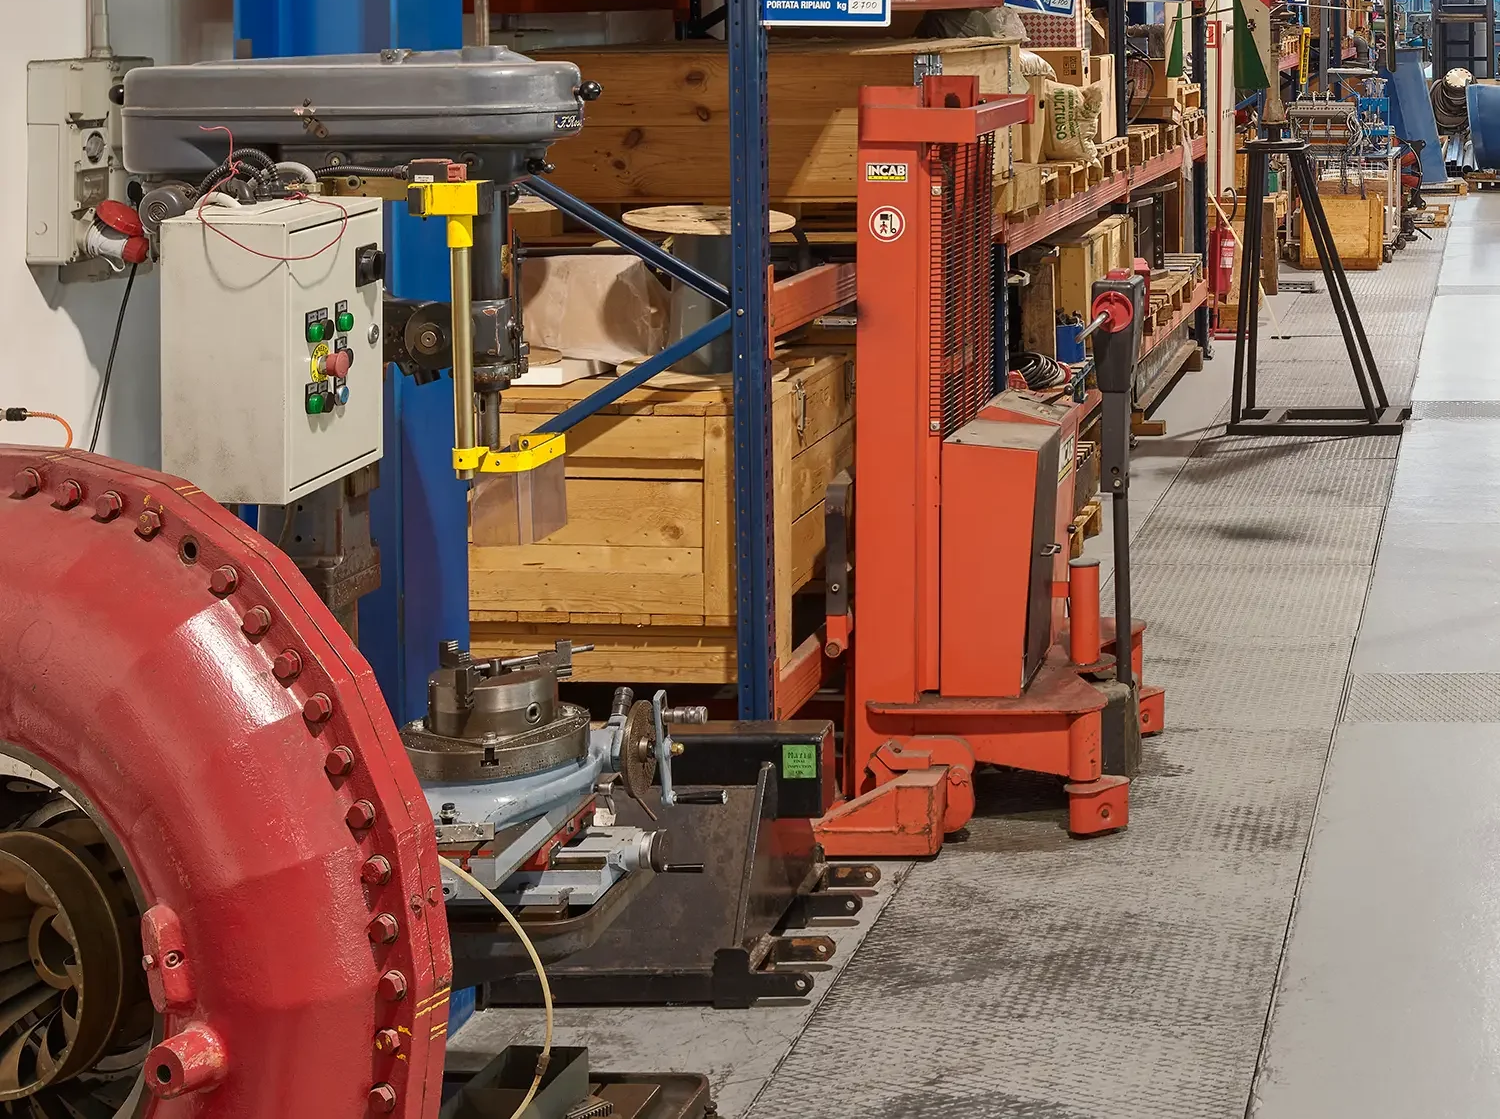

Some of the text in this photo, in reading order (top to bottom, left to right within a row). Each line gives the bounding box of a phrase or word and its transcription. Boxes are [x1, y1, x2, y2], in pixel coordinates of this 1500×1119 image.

[766, 1, 878, 11] PORTATA RIPIANO kg 2700
[1053, 88, 1067, 141] MULTIUSO
[868, 165, 906, 176] INCAB
